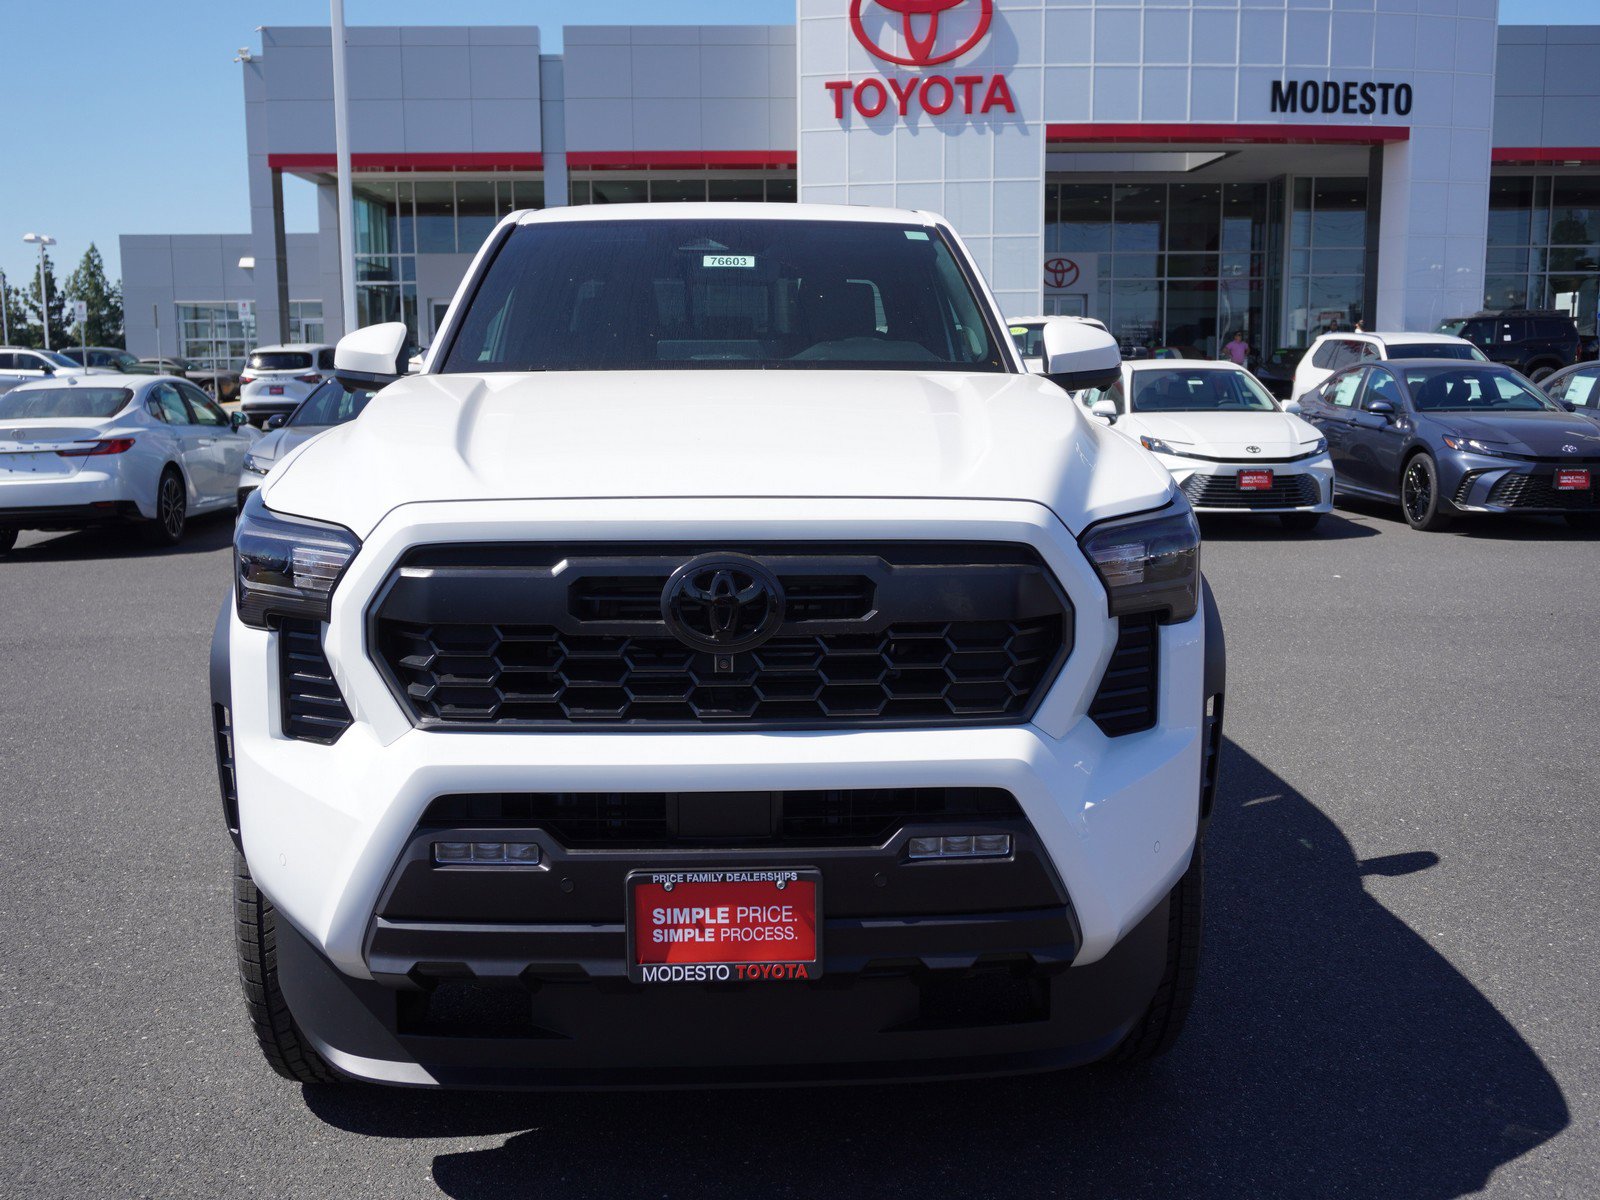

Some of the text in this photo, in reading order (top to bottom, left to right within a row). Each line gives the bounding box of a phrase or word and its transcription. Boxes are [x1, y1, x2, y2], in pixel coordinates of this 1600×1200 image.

[825, 74, 1016, 119] TOYOTA
[1271, 80, 1412, 116] MODESTO
[710, 257, 747, 266] 76603
[652, 872, 798, 884] PRICE FAMILY DEALERSHIPS
[652, 905, 798, 925] SIMPLE PRICE.
[652, 926, 798, 943] SIMPLE PROCESS.
[642, 963, 809, 982] MODESTO TOYOTA
